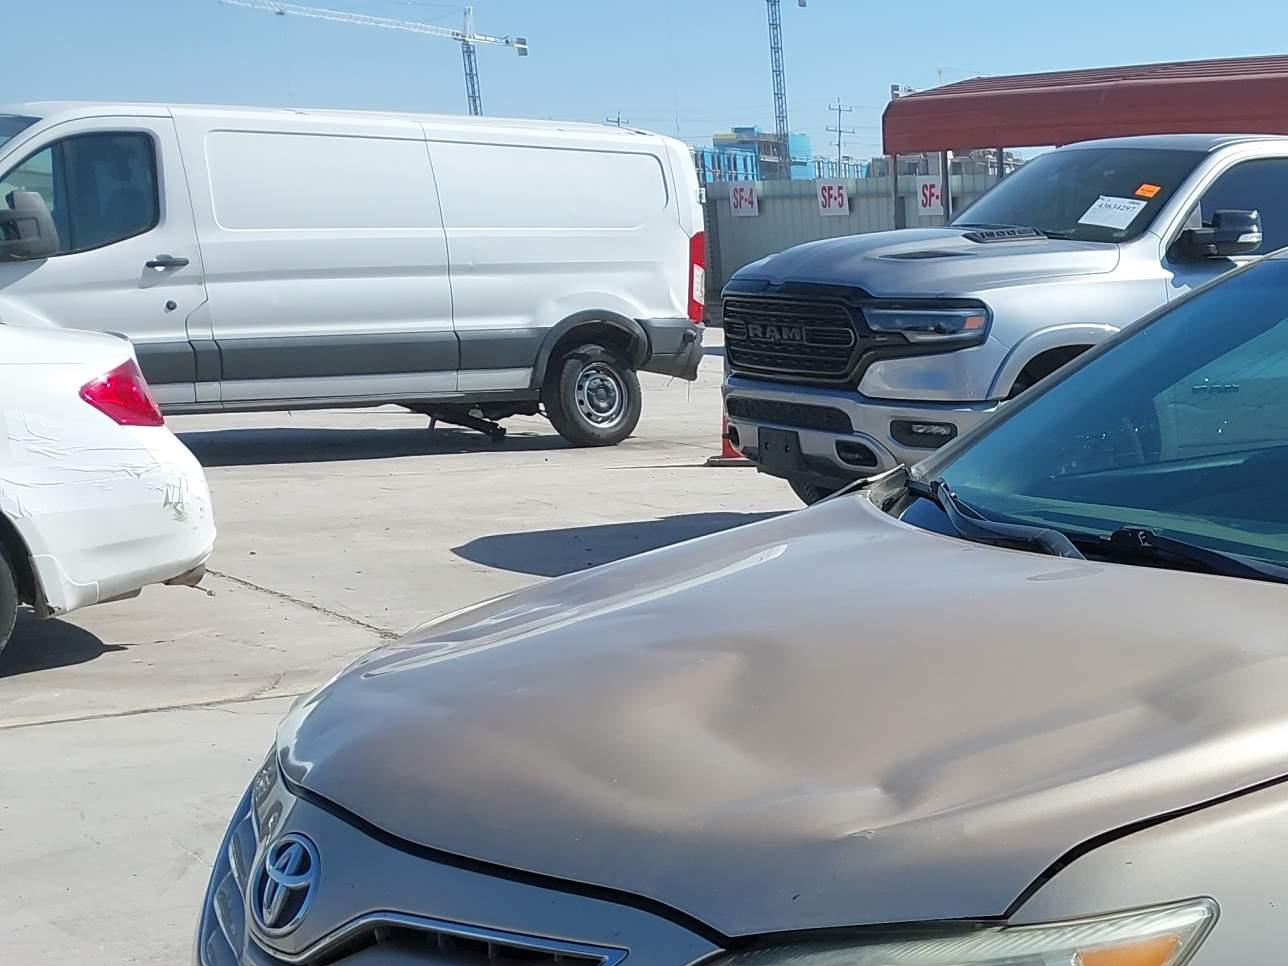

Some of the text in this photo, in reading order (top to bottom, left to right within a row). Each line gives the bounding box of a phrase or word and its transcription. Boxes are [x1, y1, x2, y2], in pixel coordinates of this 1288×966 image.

[733, 187, 754, 209] SF-4
[821, 185, 844, 209] SF-5
[749, 323, 800, 341] RAM
